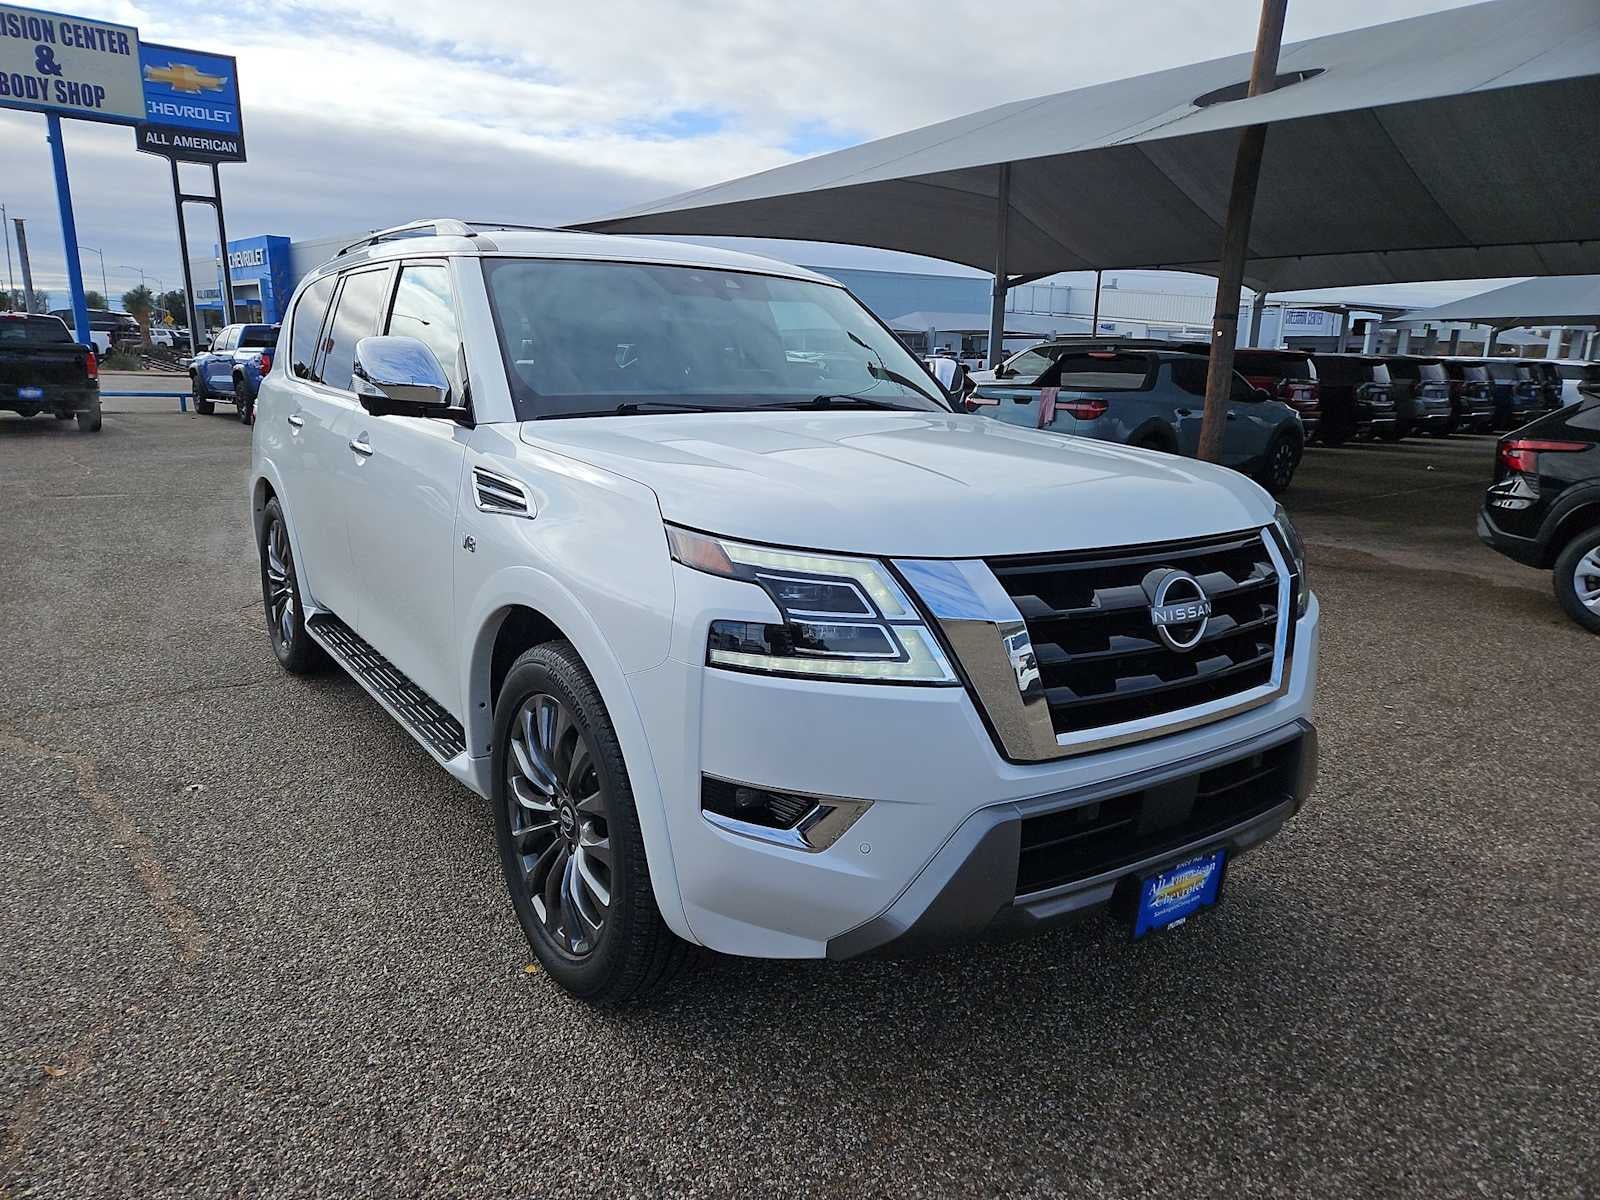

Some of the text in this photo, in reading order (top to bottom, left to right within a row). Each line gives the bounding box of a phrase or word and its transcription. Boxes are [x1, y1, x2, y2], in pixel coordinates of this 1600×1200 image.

[0, 12, 130, 56] ISION CENTER
[35, 44, 63, 77] &
[0, 72, 105, 108] BODY SHOP
[146, 132, 238, 153] ALL AMERICAN
[228, 248, 264, 269] CHEVROLET
[1154, 602, 1212, 623] NISSAN
